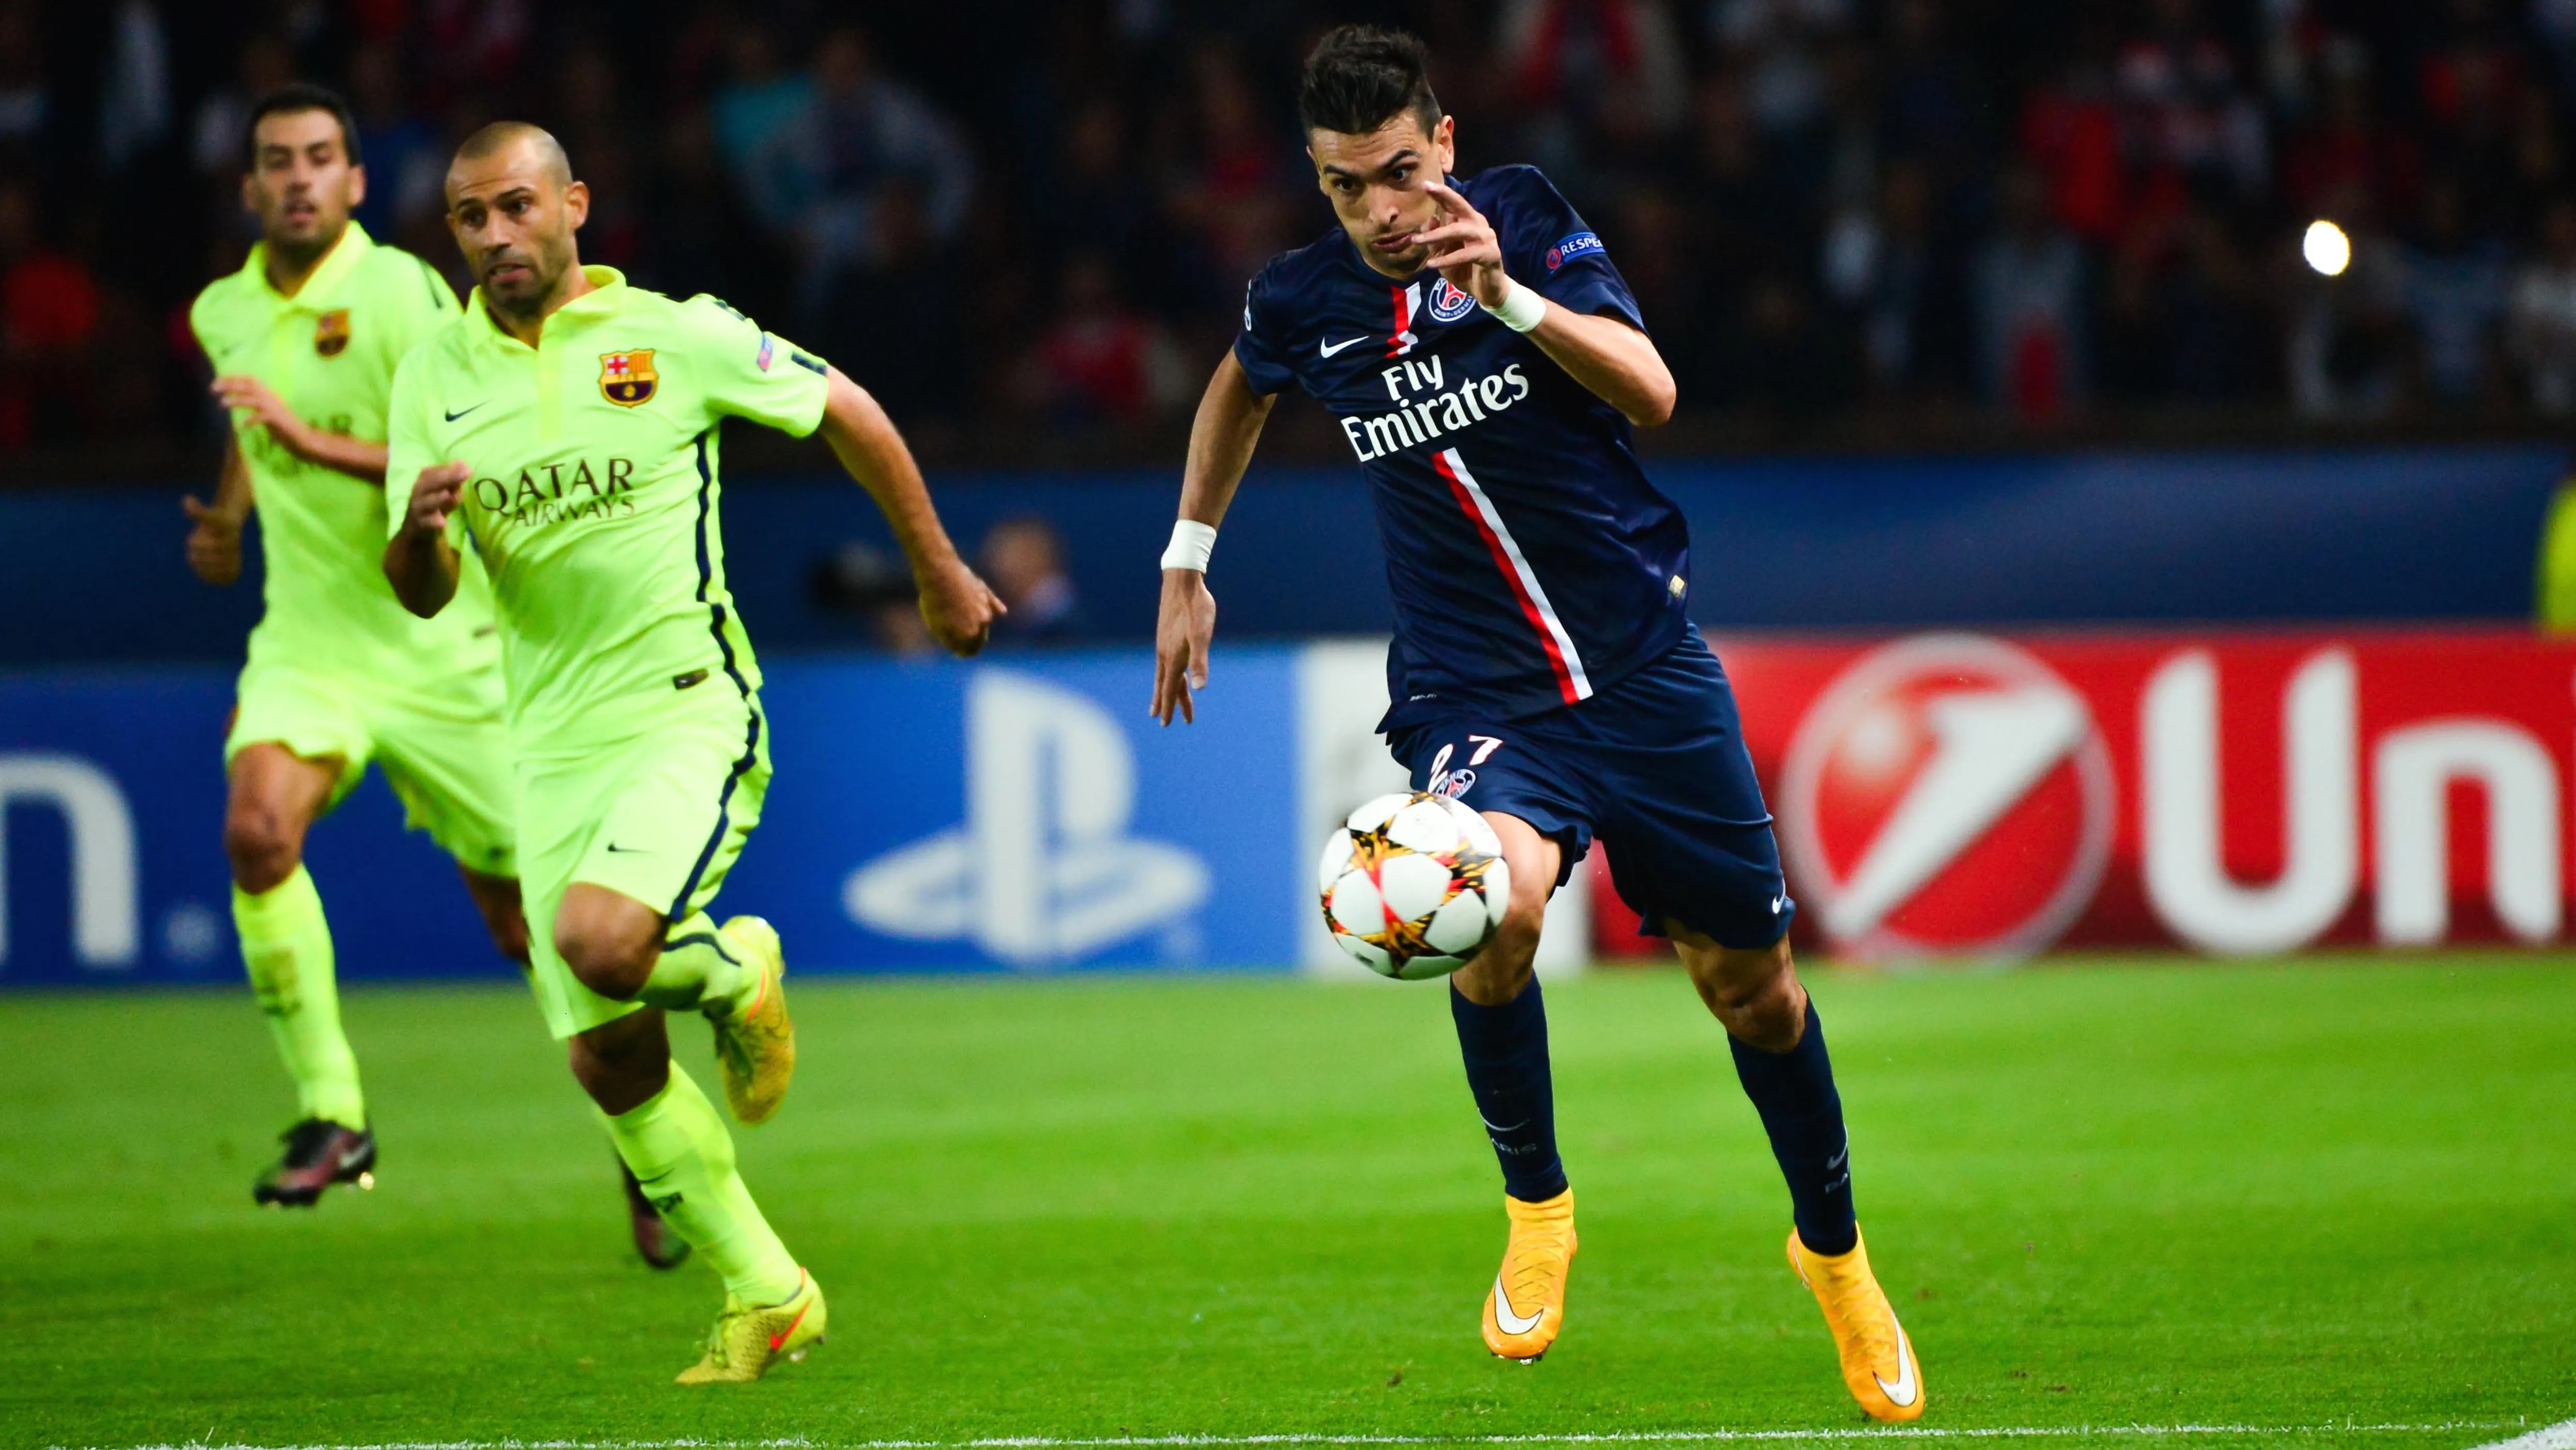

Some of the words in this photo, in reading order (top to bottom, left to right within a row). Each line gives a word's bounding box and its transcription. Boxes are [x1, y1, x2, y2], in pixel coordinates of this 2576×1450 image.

[1381, 354, 1444, 401] Fly
[1340, 363, 1529, 462] Emirates
[474, 458, 634, 517] QATAR
[513, 495, 635, 527] AIRWAYS
[1427, 734, 1504, 795] 27
[2139, 644, 2576, 957] Un
